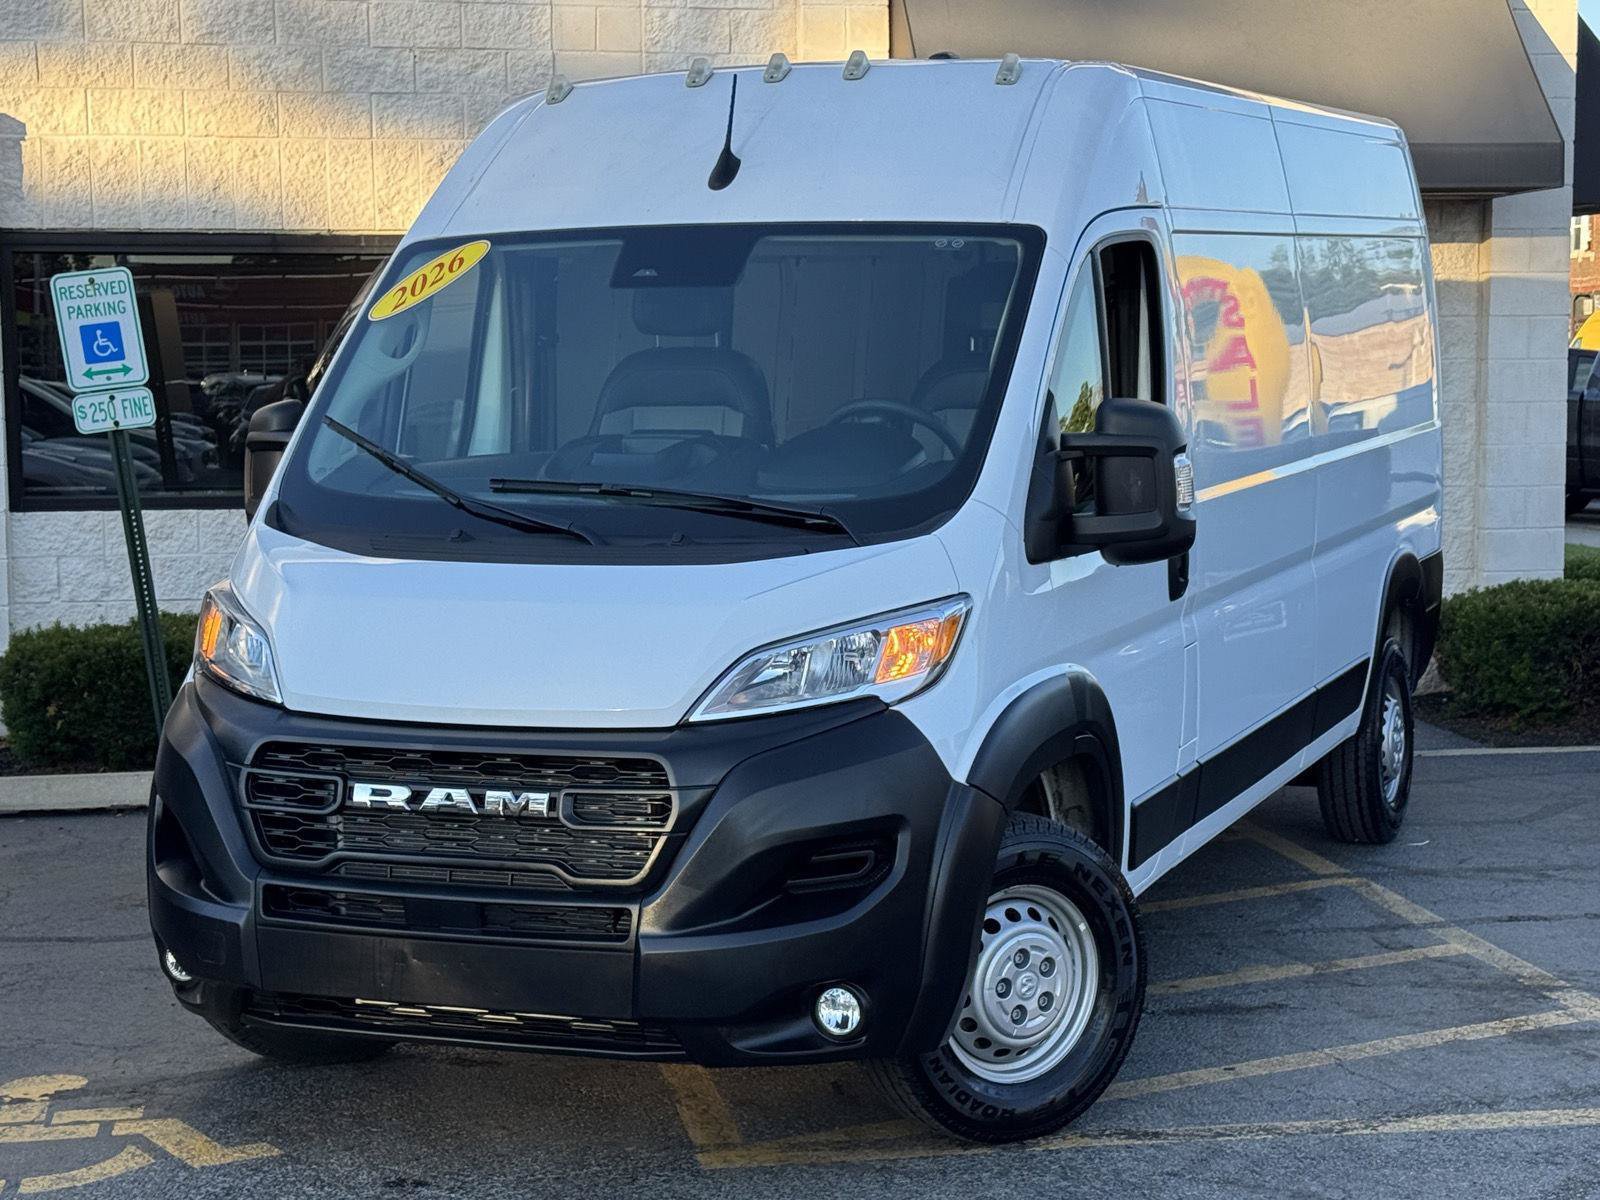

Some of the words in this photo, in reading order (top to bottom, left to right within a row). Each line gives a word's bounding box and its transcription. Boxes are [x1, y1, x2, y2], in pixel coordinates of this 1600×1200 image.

[58, 280, 127, 301] RESERVED
[391, 248, 464, 312] 2026
[67, 300, 127, 320] PARKING
[78, 400, 117, 424] $250
[121, 395, 152, 419] FINE
[352, 782, 550, 818] RAM
[1073, 861, 1133, 966] NEXEN
[928, 1055, 1016, 1121] ROADIAN
